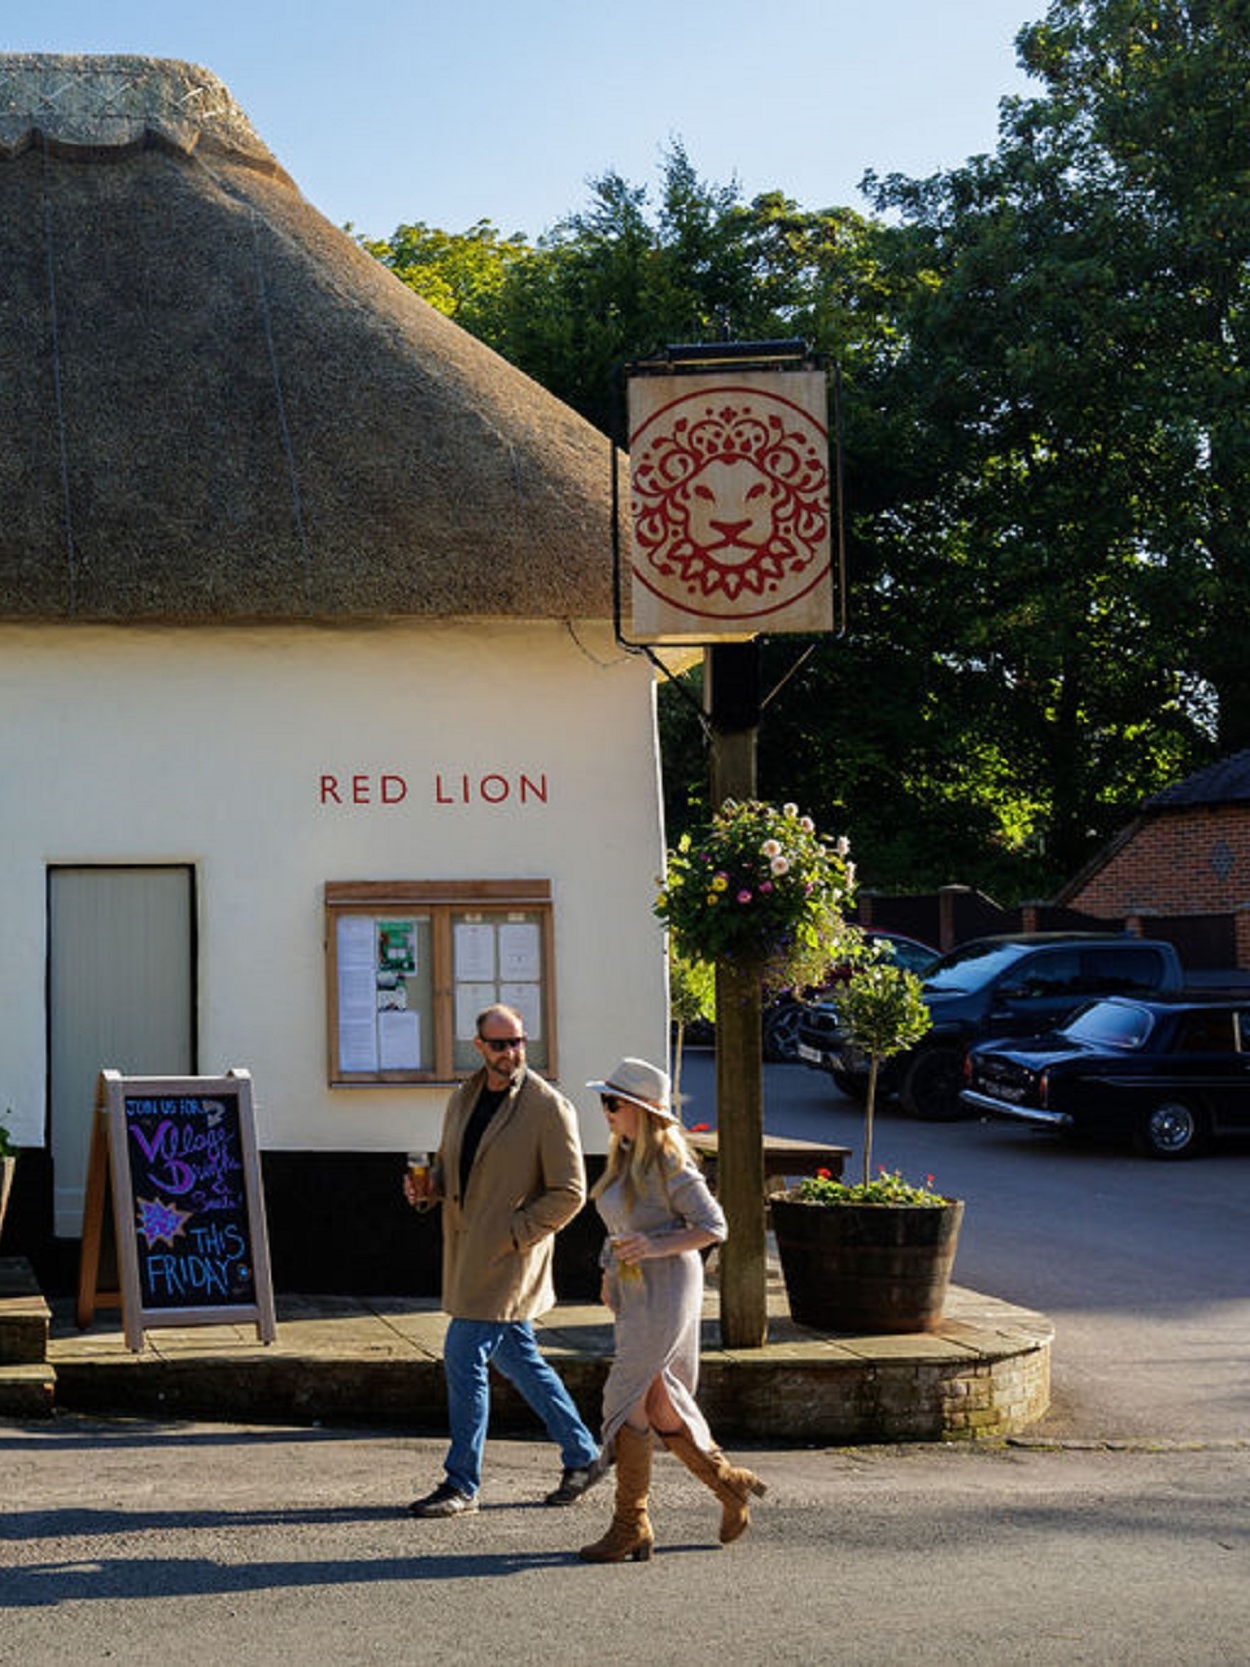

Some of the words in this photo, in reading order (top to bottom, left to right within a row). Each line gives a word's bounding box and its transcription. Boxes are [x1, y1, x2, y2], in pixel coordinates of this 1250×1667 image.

[320, 774, 407, 804] RED
[436, 773, 548, 804] LION
[161, 1099, 176, 1114] US
[129, 1120, 234, 1163] Village
[190, 1222, 245, 1260] THIS
[146, 1254, 229, 1296] FRIDAY
